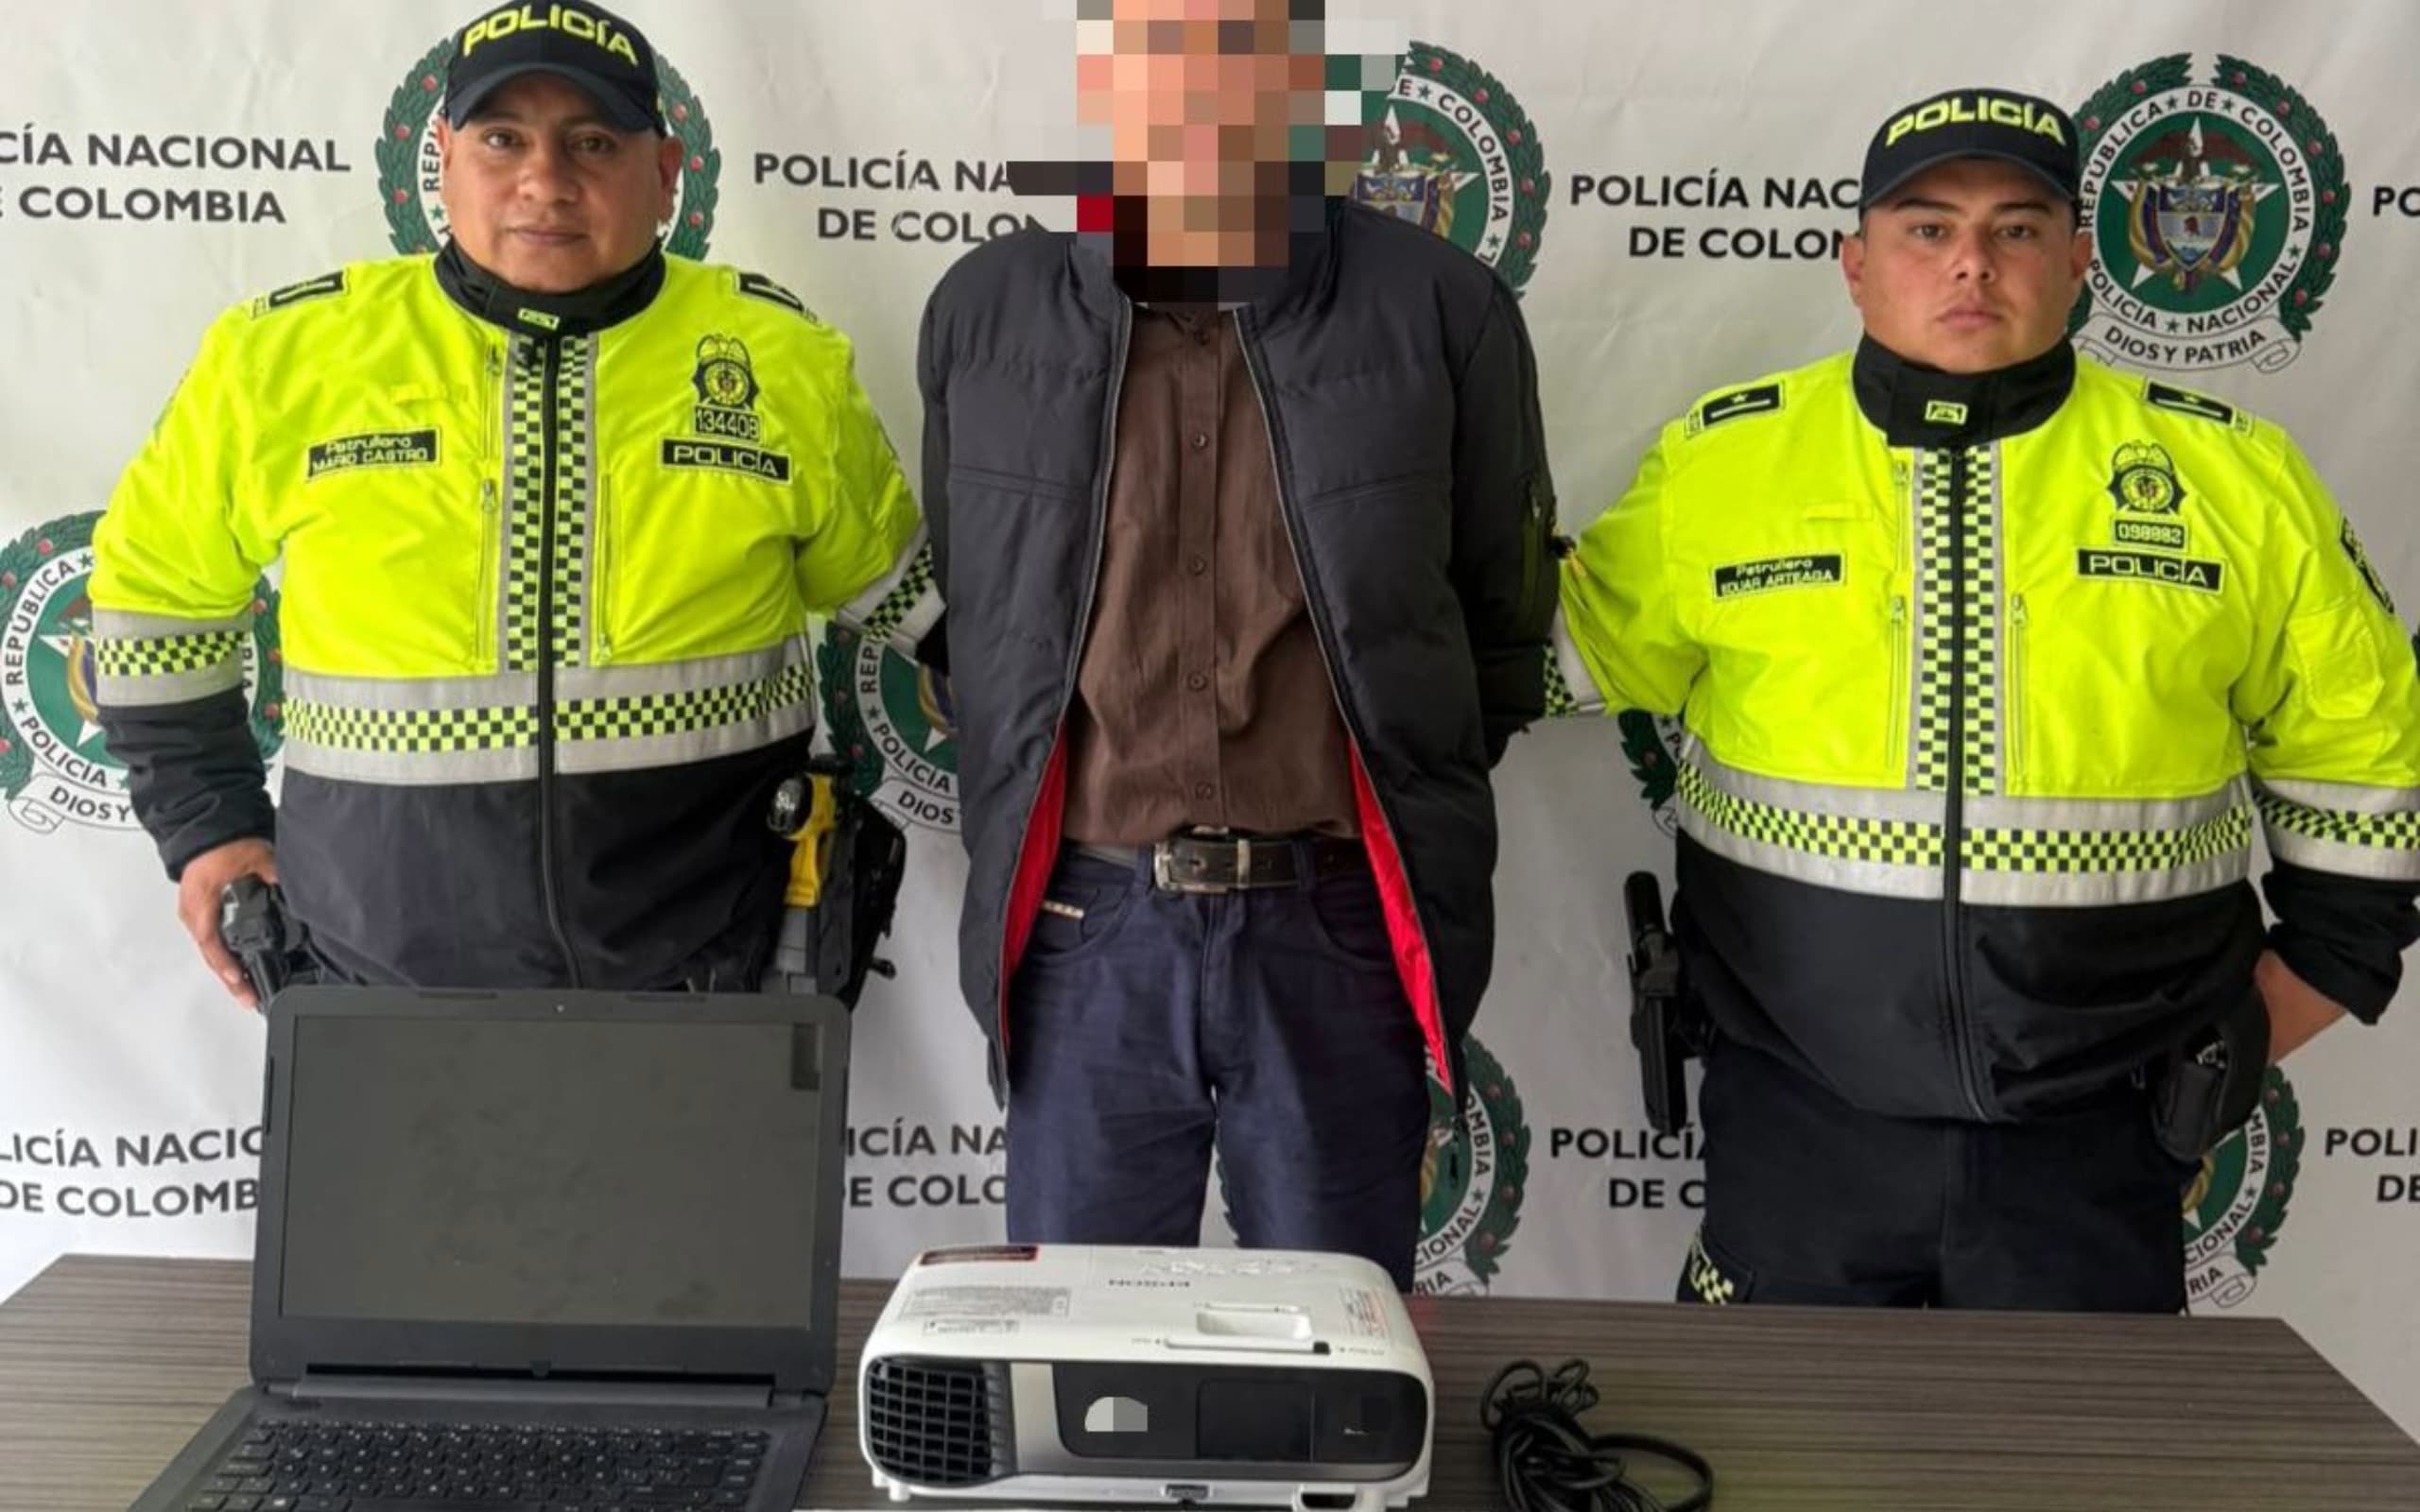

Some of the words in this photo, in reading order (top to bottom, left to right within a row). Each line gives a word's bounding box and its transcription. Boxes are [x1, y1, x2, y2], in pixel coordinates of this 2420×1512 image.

[88, 133, 351, 172] NACIONAL
[754, 149, 941, 191] POLICÍA
[1438, 93, 1510, 222] COLOMBIA
[2187, 90, 2219, 109] DE
[2239, 105, 2310, 232] COLOMBIA
[18, 185, 286, 224] COLOMBIA
[1570, 167, 1749, 208] POLICÍA
[818, 207, 877, 240] DE
[1629, 227, 1685, 258] DE
[2187, 260, 2296, 334] NACIONAL
[2104, 326, 2159, 361] DIOS
[2185, 330, 2266, 364] PATRIA
[49, 785, 112, 820] DIOS
[899, 791, 954, 825] DIOS
[1609, 1177, 1665, 1209] DE
